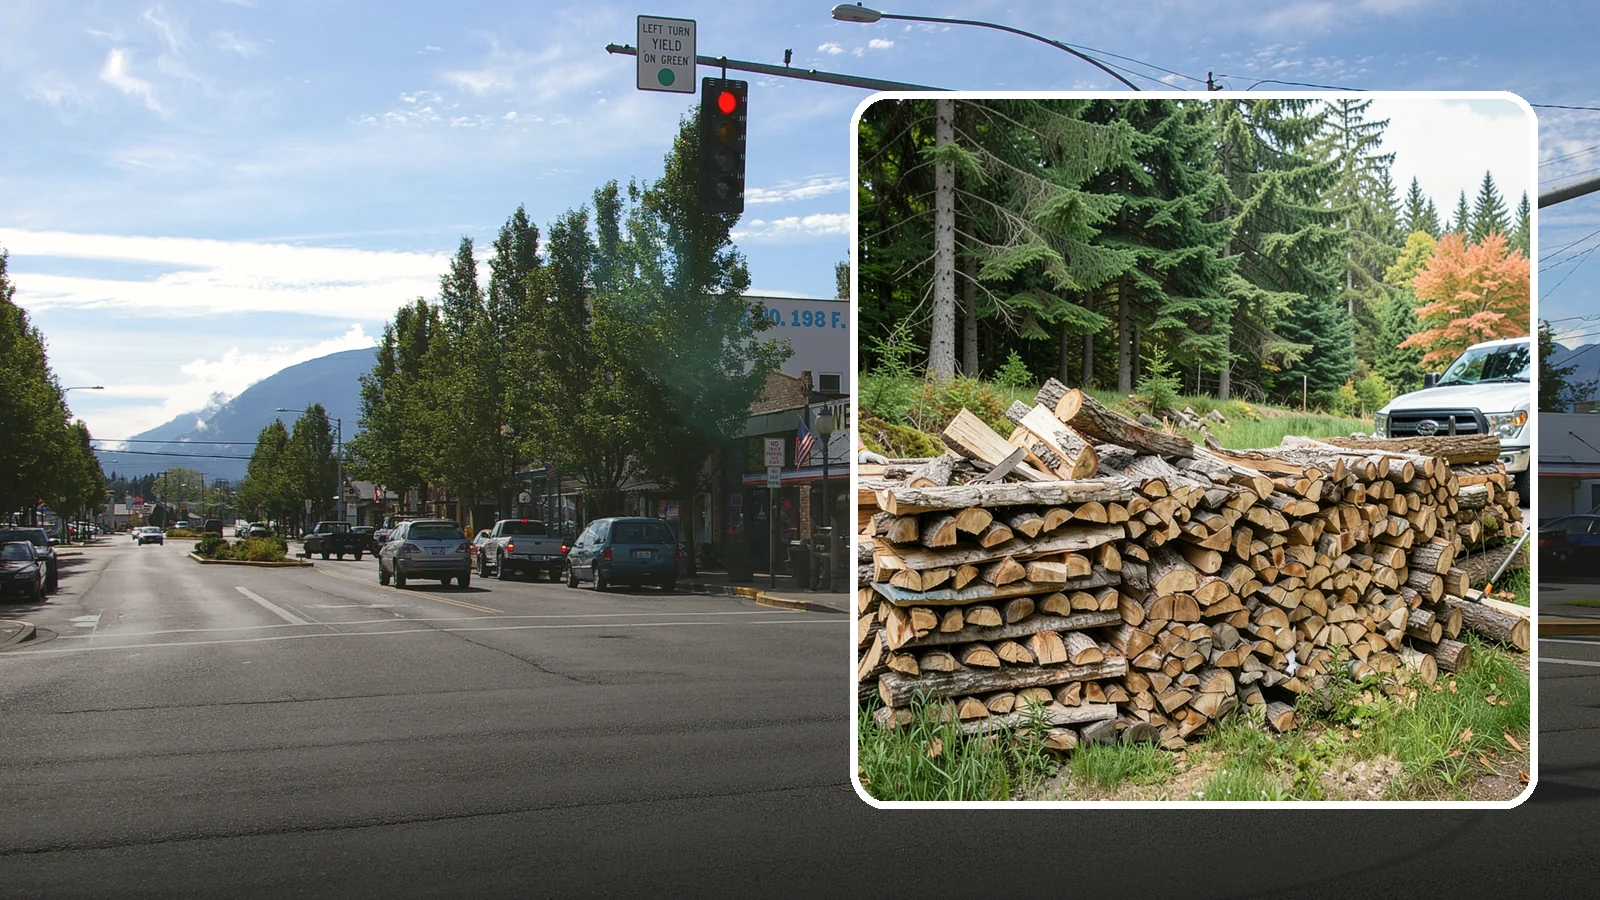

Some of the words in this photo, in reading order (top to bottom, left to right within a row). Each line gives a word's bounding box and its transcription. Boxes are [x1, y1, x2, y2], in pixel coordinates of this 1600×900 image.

[643, 23, 663, 34] LEFT
[668, 25, 690, 36] TURN
[652, 38, 682, 52] YIELD
[644, 53, 656, 64] ON
[661, 54, 689, 66] GREEN
[791, 309, 826, 328] 198
[831, 311, 847, 329] F.
